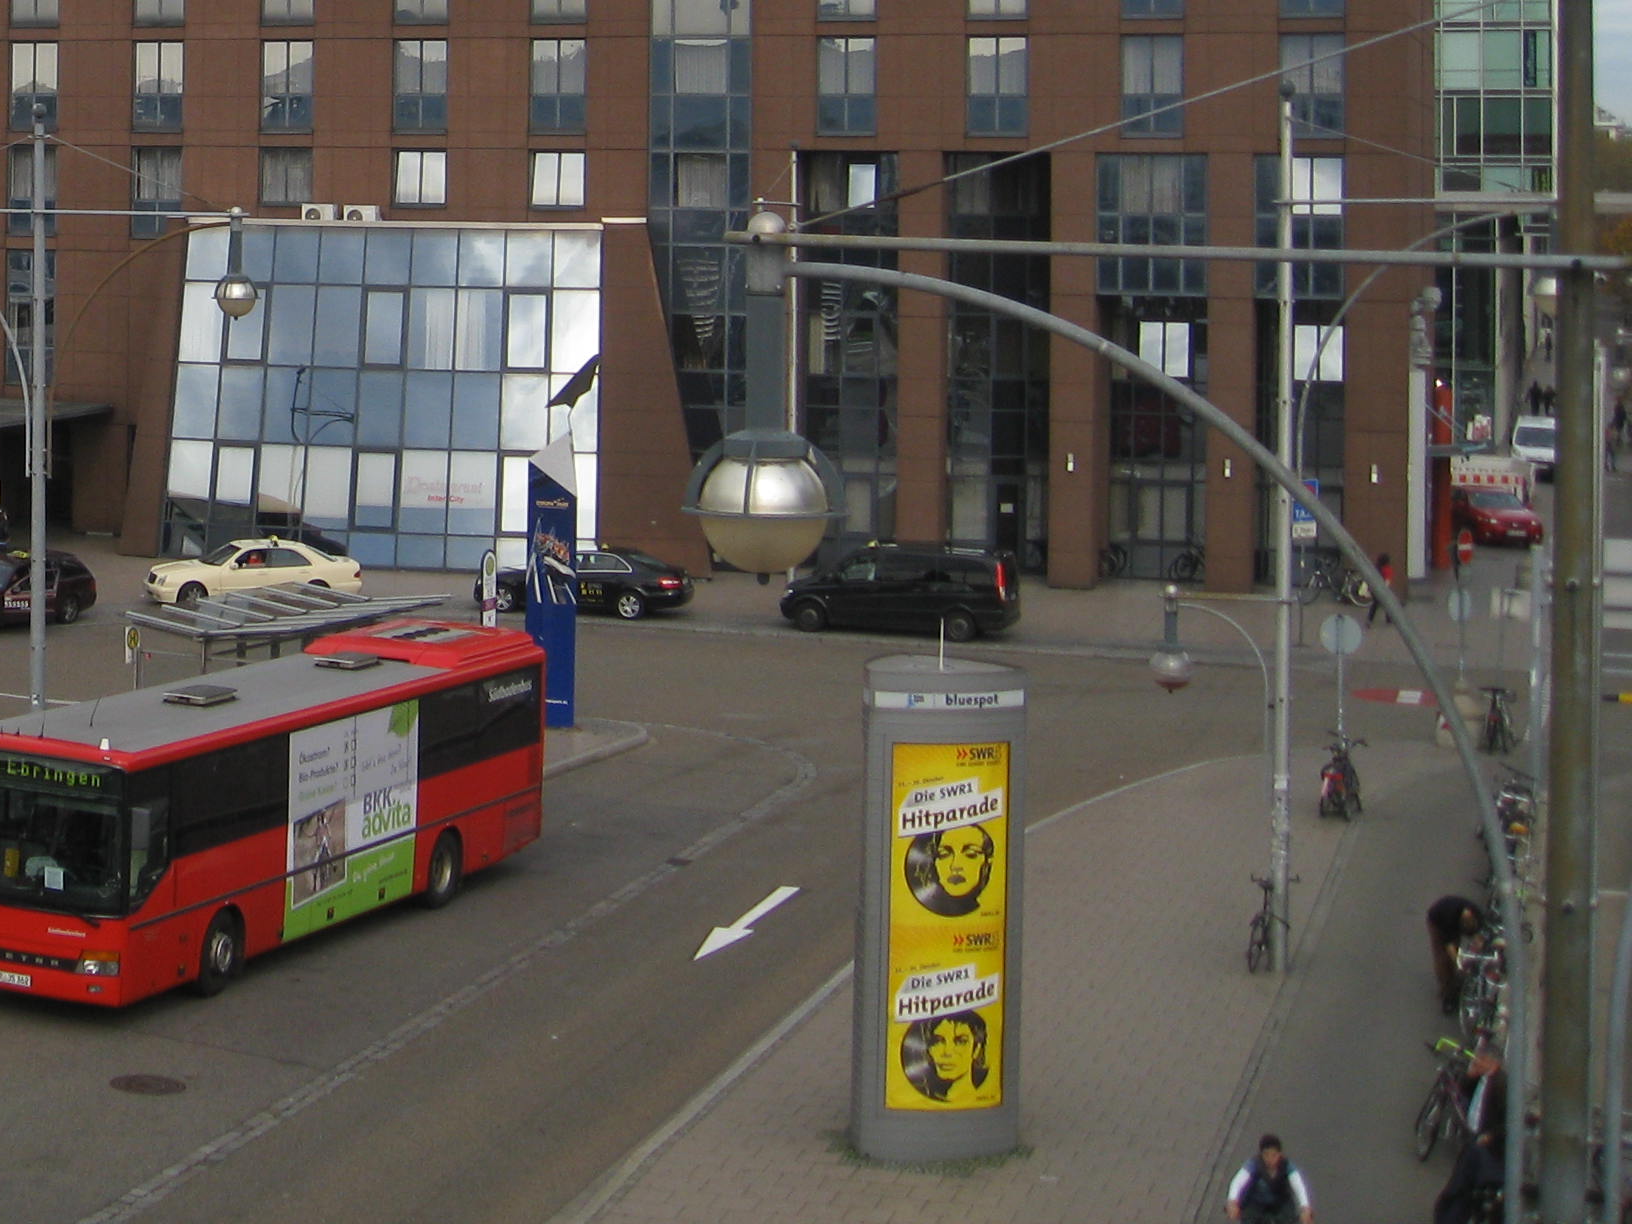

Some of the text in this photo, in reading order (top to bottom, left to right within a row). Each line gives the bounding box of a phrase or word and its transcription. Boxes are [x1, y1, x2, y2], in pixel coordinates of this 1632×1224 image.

[945, 693, 999, 708] bluespot
[914, 789, 936, 804] Die
[939, 782, 974, 799] SWR1
[902, 794, 999, 830] Hitparade
[911, 976, 933, 990] Die
[936, 968, 970, 985] SWR1
[898, 981, 995, 1016] Hitparade
